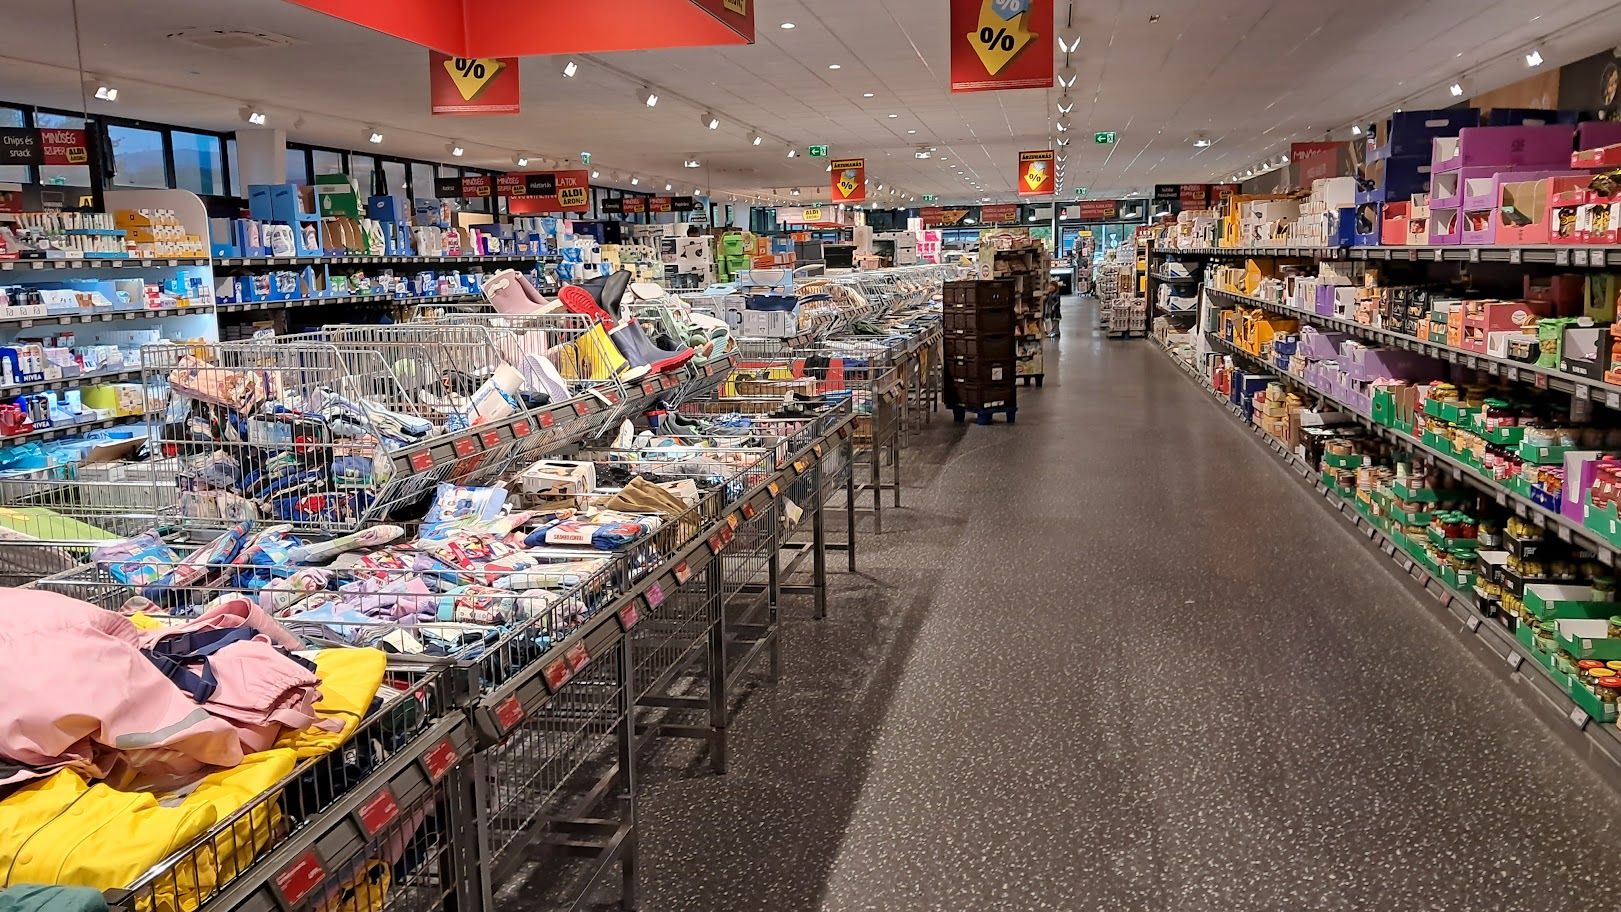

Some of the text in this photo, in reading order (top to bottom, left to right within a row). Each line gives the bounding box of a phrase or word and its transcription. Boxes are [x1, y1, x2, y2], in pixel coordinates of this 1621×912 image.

[980, 27, 1015, 51] %
[455, 58, 485, 79] %
[3, 135, 33, 146] Chips és
[42, 131, 76, 145] MINŐSÉG
[9, 149, 31, 157] snack
[841, 181, 853, 190] %
[562, 188, 582, 198] ALDI
[23, 374, 42, 382] NIVEA
[32, 421, 50, 429] NIVEA
